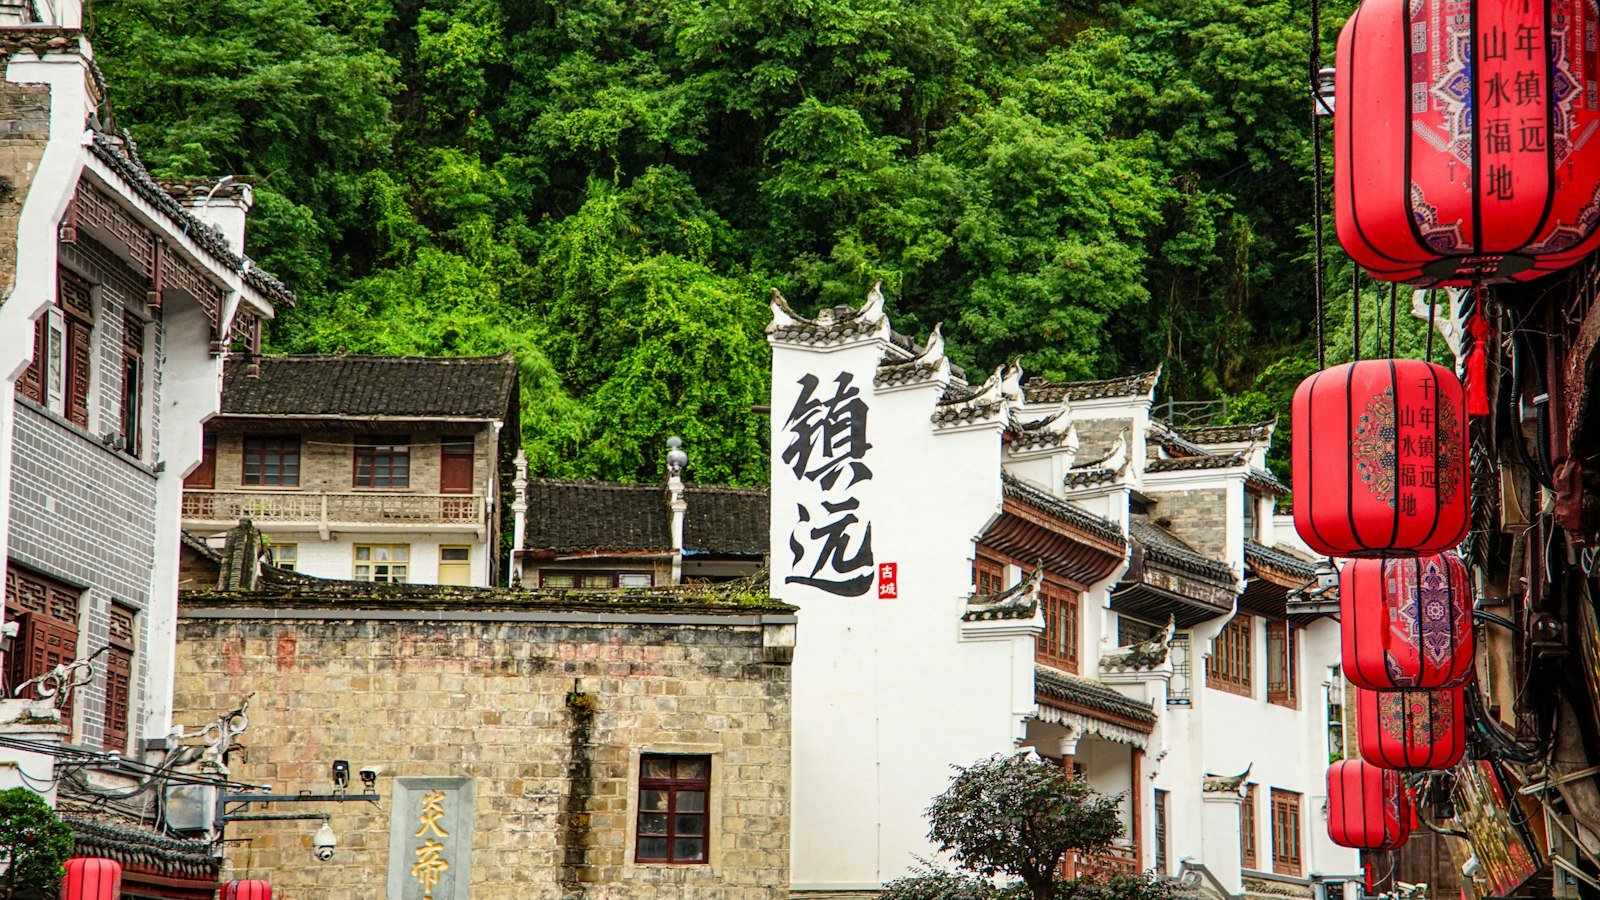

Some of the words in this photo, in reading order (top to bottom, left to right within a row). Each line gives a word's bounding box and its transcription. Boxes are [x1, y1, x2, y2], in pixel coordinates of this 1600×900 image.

[1483, 25, 1514, 200] 山水福地
[781, 371, 874, 597] 镇远
[1400, 405, 1417, 517] 山水福地
[1418, 378, 1437, 489] 千年镇远
[879, 565, 897, 596] 古城
[411, 789, 449, 900] 炎帝
